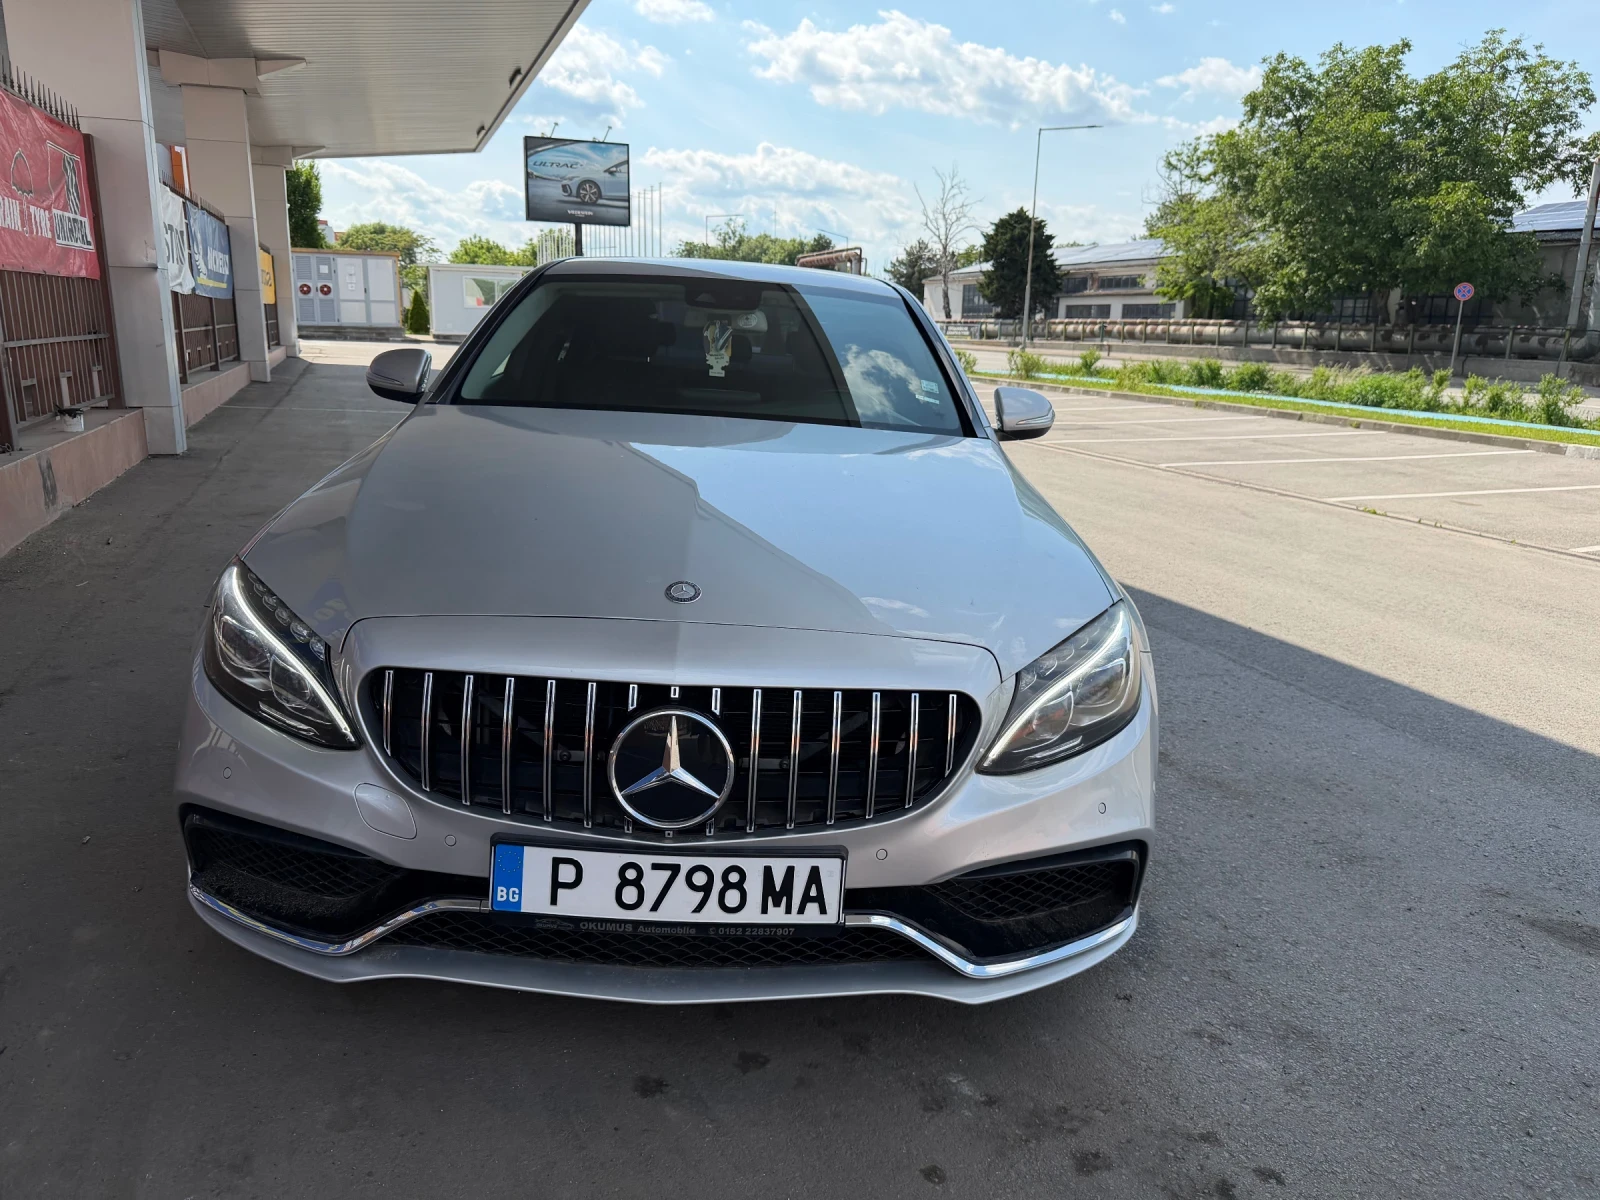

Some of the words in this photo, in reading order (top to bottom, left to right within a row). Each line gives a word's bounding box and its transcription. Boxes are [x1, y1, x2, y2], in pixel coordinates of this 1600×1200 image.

[533, 161, 578, 169] ULTRAC
[30, 205, 52, 238] TYRE
[497, 886, 519, 903] BG
[550, 857, 584, 906] P
[615, 861, 748, 914] 8798
[760, 864, 828, 915] MA
[580, 921, 633, 932] OKUMUS
[637, 925, 696, 935] Automobile
[718, 927, 742, 935] 0152
[745, 927, 795, 936] 22837907
